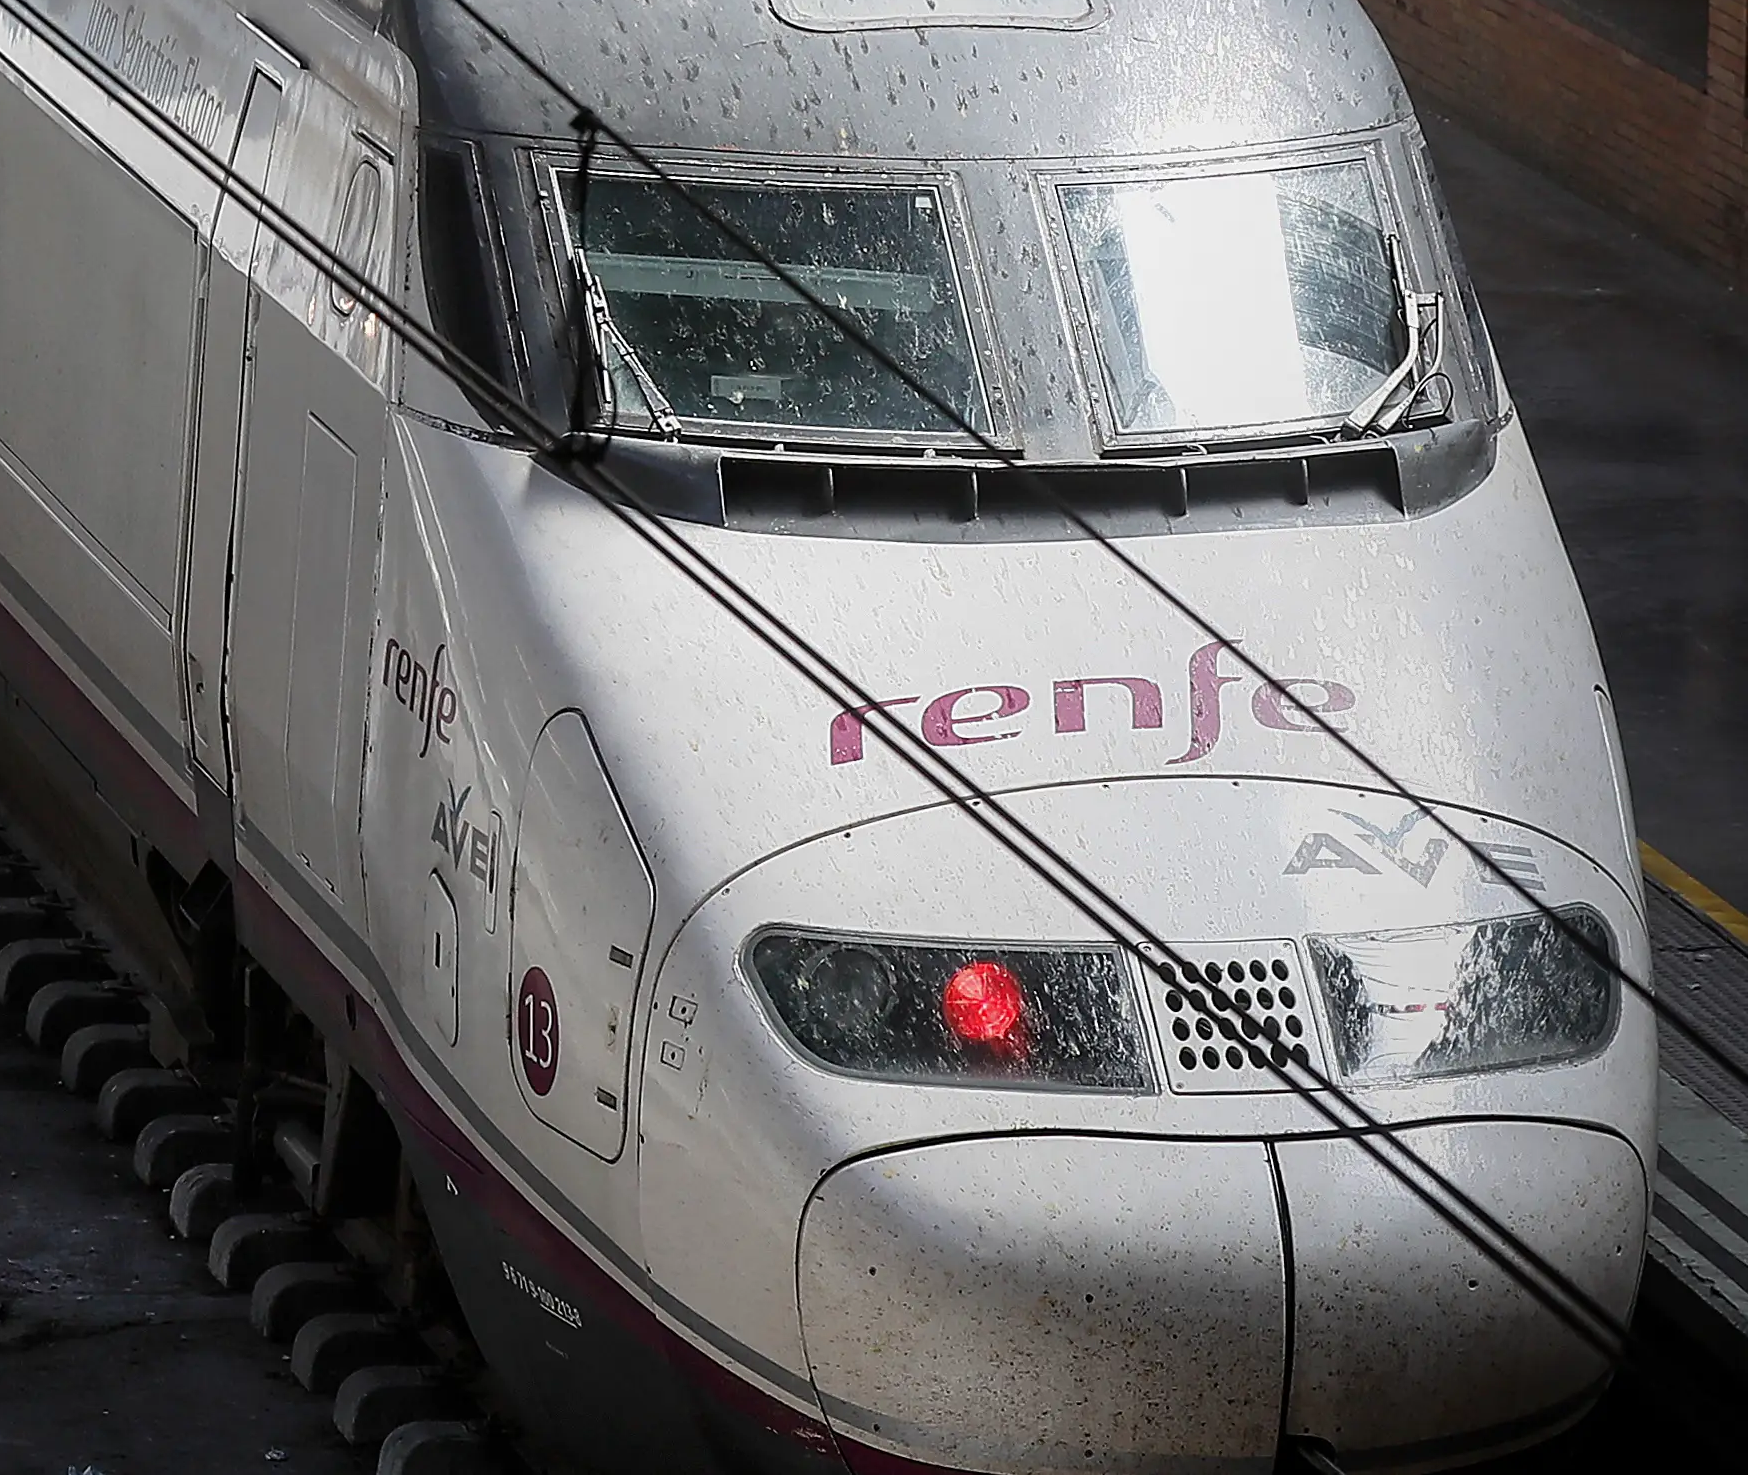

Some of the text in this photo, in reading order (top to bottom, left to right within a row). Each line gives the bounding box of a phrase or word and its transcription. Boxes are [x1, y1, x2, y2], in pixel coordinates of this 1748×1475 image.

[382, 637, 457, 759] renfe
[829, 637, 1358, 767] renfe
[431, 777, 490, 883] AVE
[1283, 808, 1549, 892] AVE
[524, 994, 553, 1069] 13
